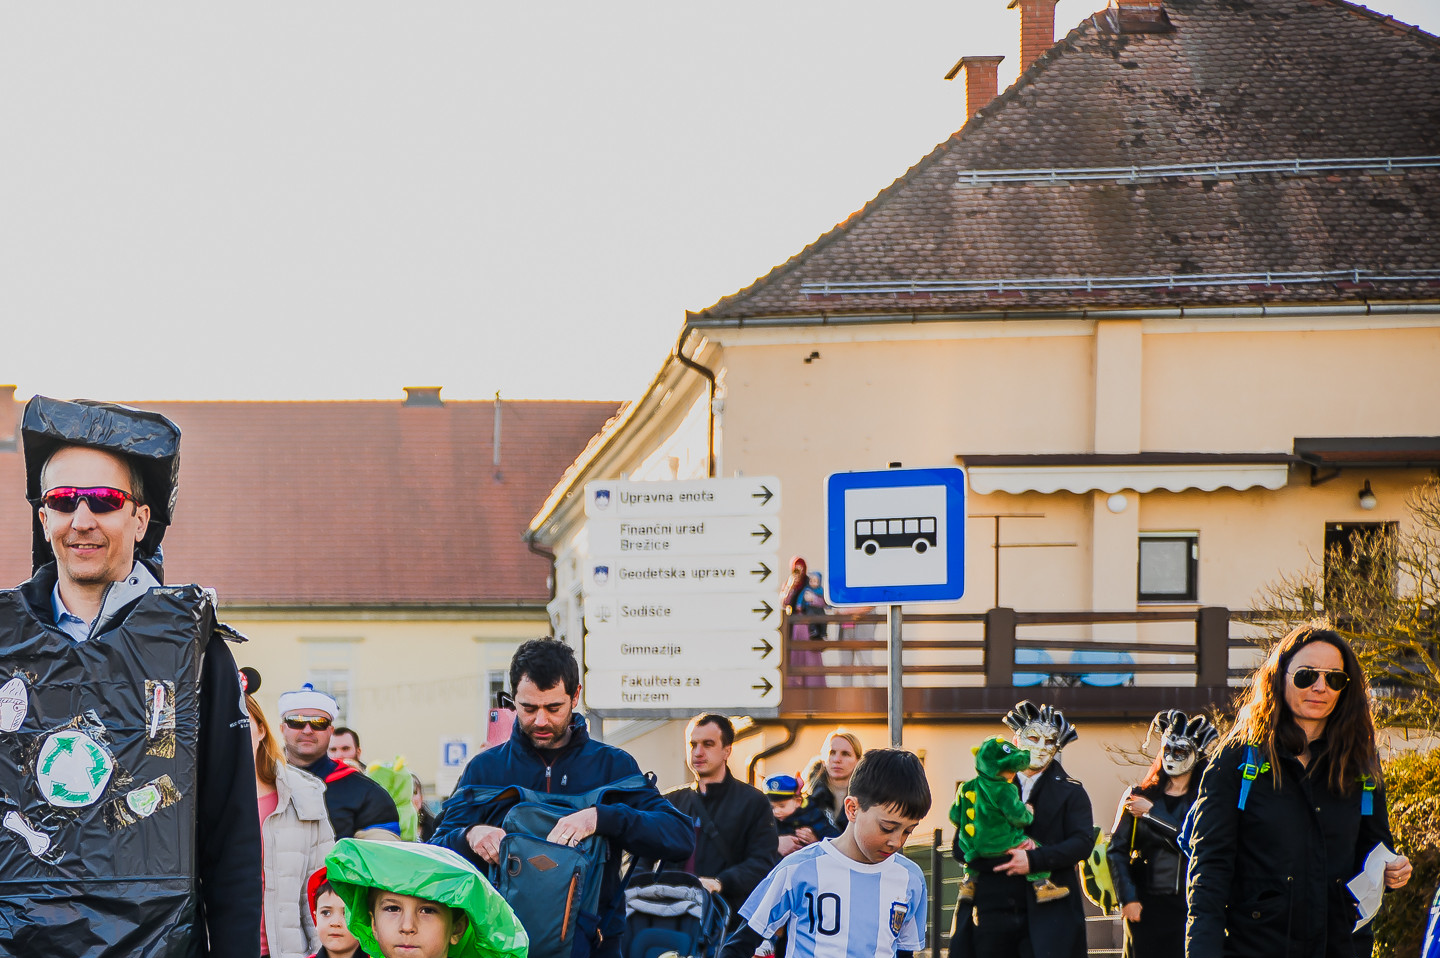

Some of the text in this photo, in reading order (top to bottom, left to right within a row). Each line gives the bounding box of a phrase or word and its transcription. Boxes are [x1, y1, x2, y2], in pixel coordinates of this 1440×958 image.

[620, 490, 714, 506] Upravna enota
[620, 522, 704, 535] Finančni urad
[620, 539, 669, 551] Brežice
[619, 567, 735, 581] Geodetska uprava
[621, 605, 671, 617] Sodišče
[621, 643, 681, 658] Gimnazija
[621, 675, 700, 687] Fakulteta za
[621, 691, 669, 702] turizem
[805, 892, 841, 936] 10
